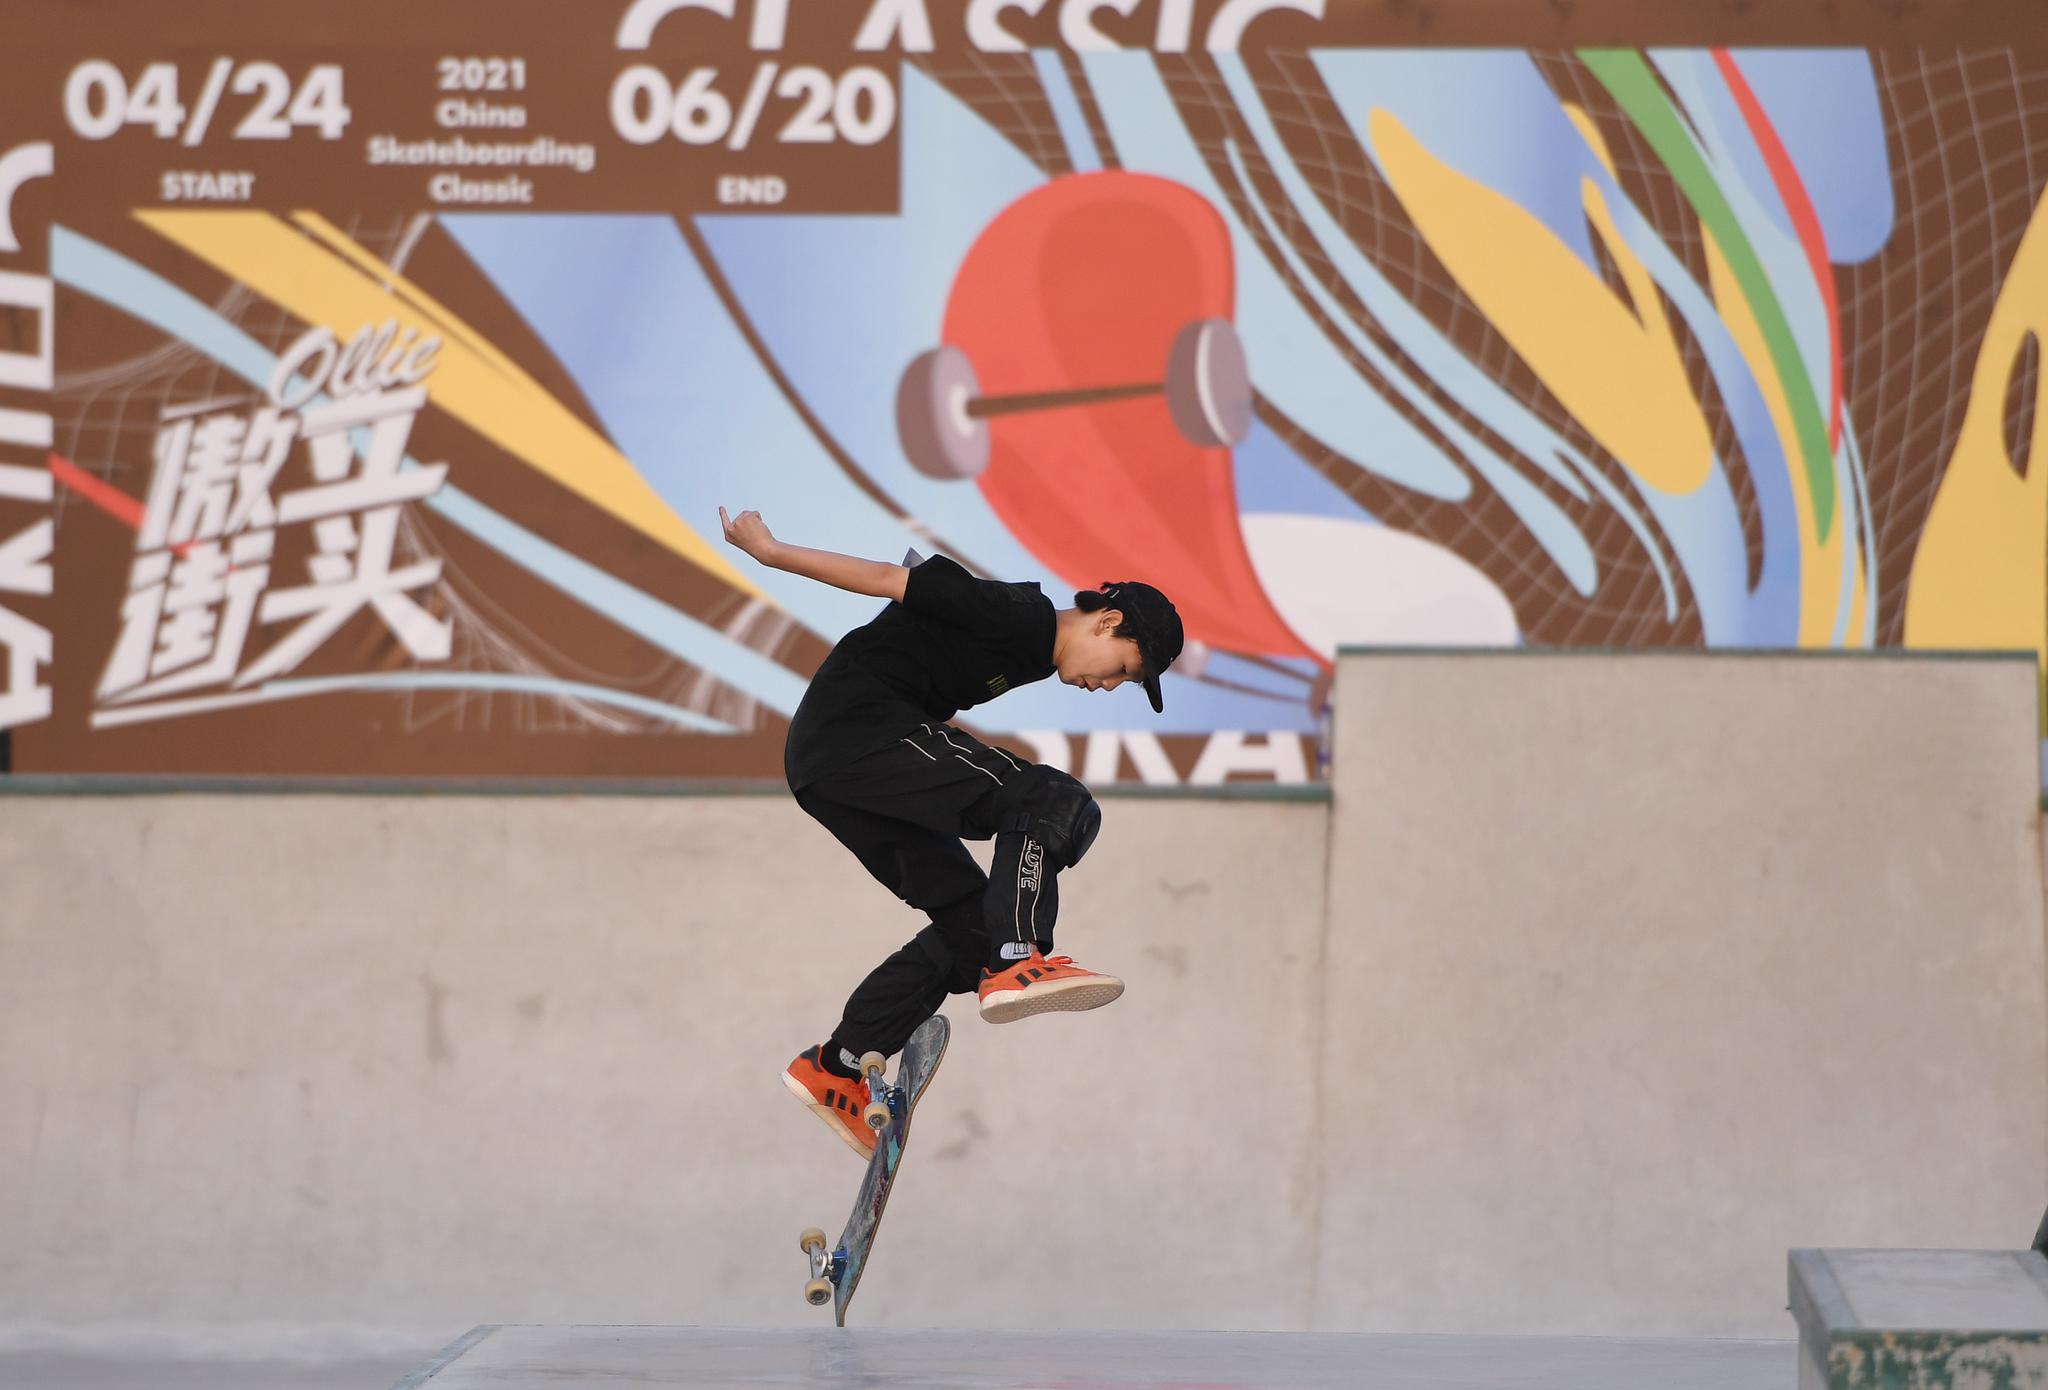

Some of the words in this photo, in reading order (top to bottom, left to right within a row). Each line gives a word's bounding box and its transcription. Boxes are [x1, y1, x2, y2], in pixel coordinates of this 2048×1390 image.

[437, 58, 527, 91] 2021
[64, 57, 350, 146] 04/24
[436, 99, 528, 129] China
[609, 63, 896, 150] 06/20
[366, 136, 597, 172] Skateboarding
[161, 172, 255, 201] START
[429, 173, 535, 204] Classic
[718, 177, 787, 205] END
[268, 317, 443, 409] Ollie
